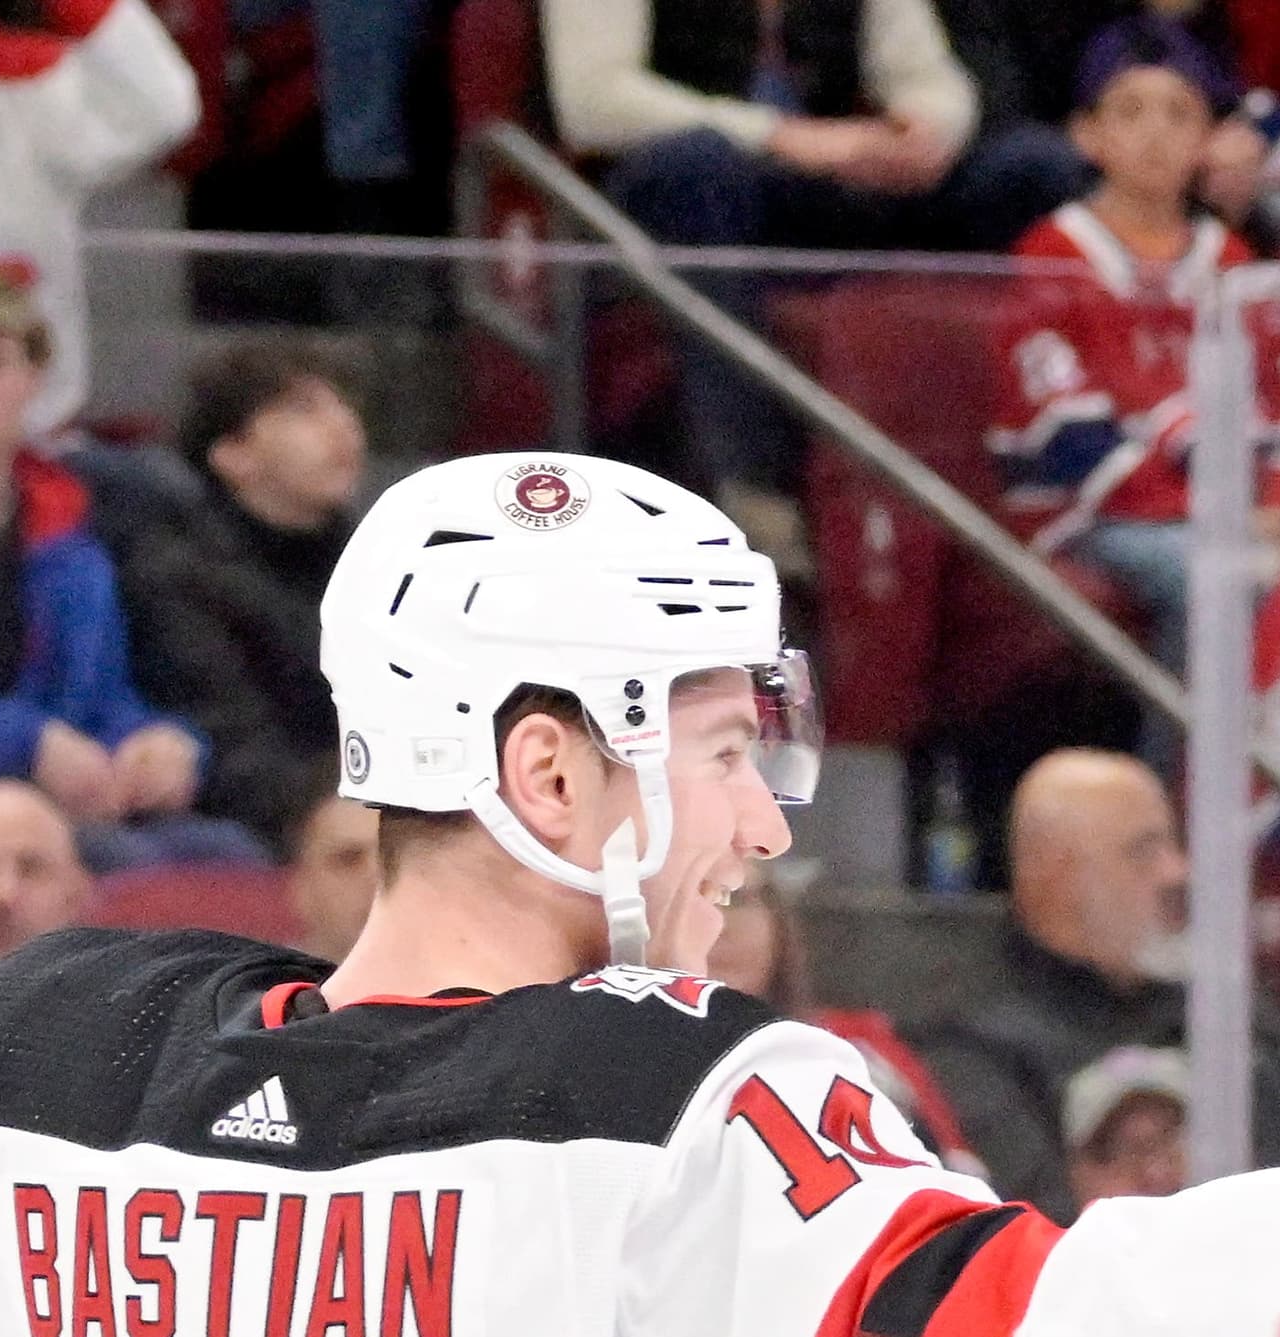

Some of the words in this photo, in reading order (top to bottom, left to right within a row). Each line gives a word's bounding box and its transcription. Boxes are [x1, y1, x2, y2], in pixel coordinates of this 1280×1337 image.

[503, 502, 550, 528] COFFEE
[552, 496, 587, 525] HOUSE
[210, 1115, 298, 1145] adidas
